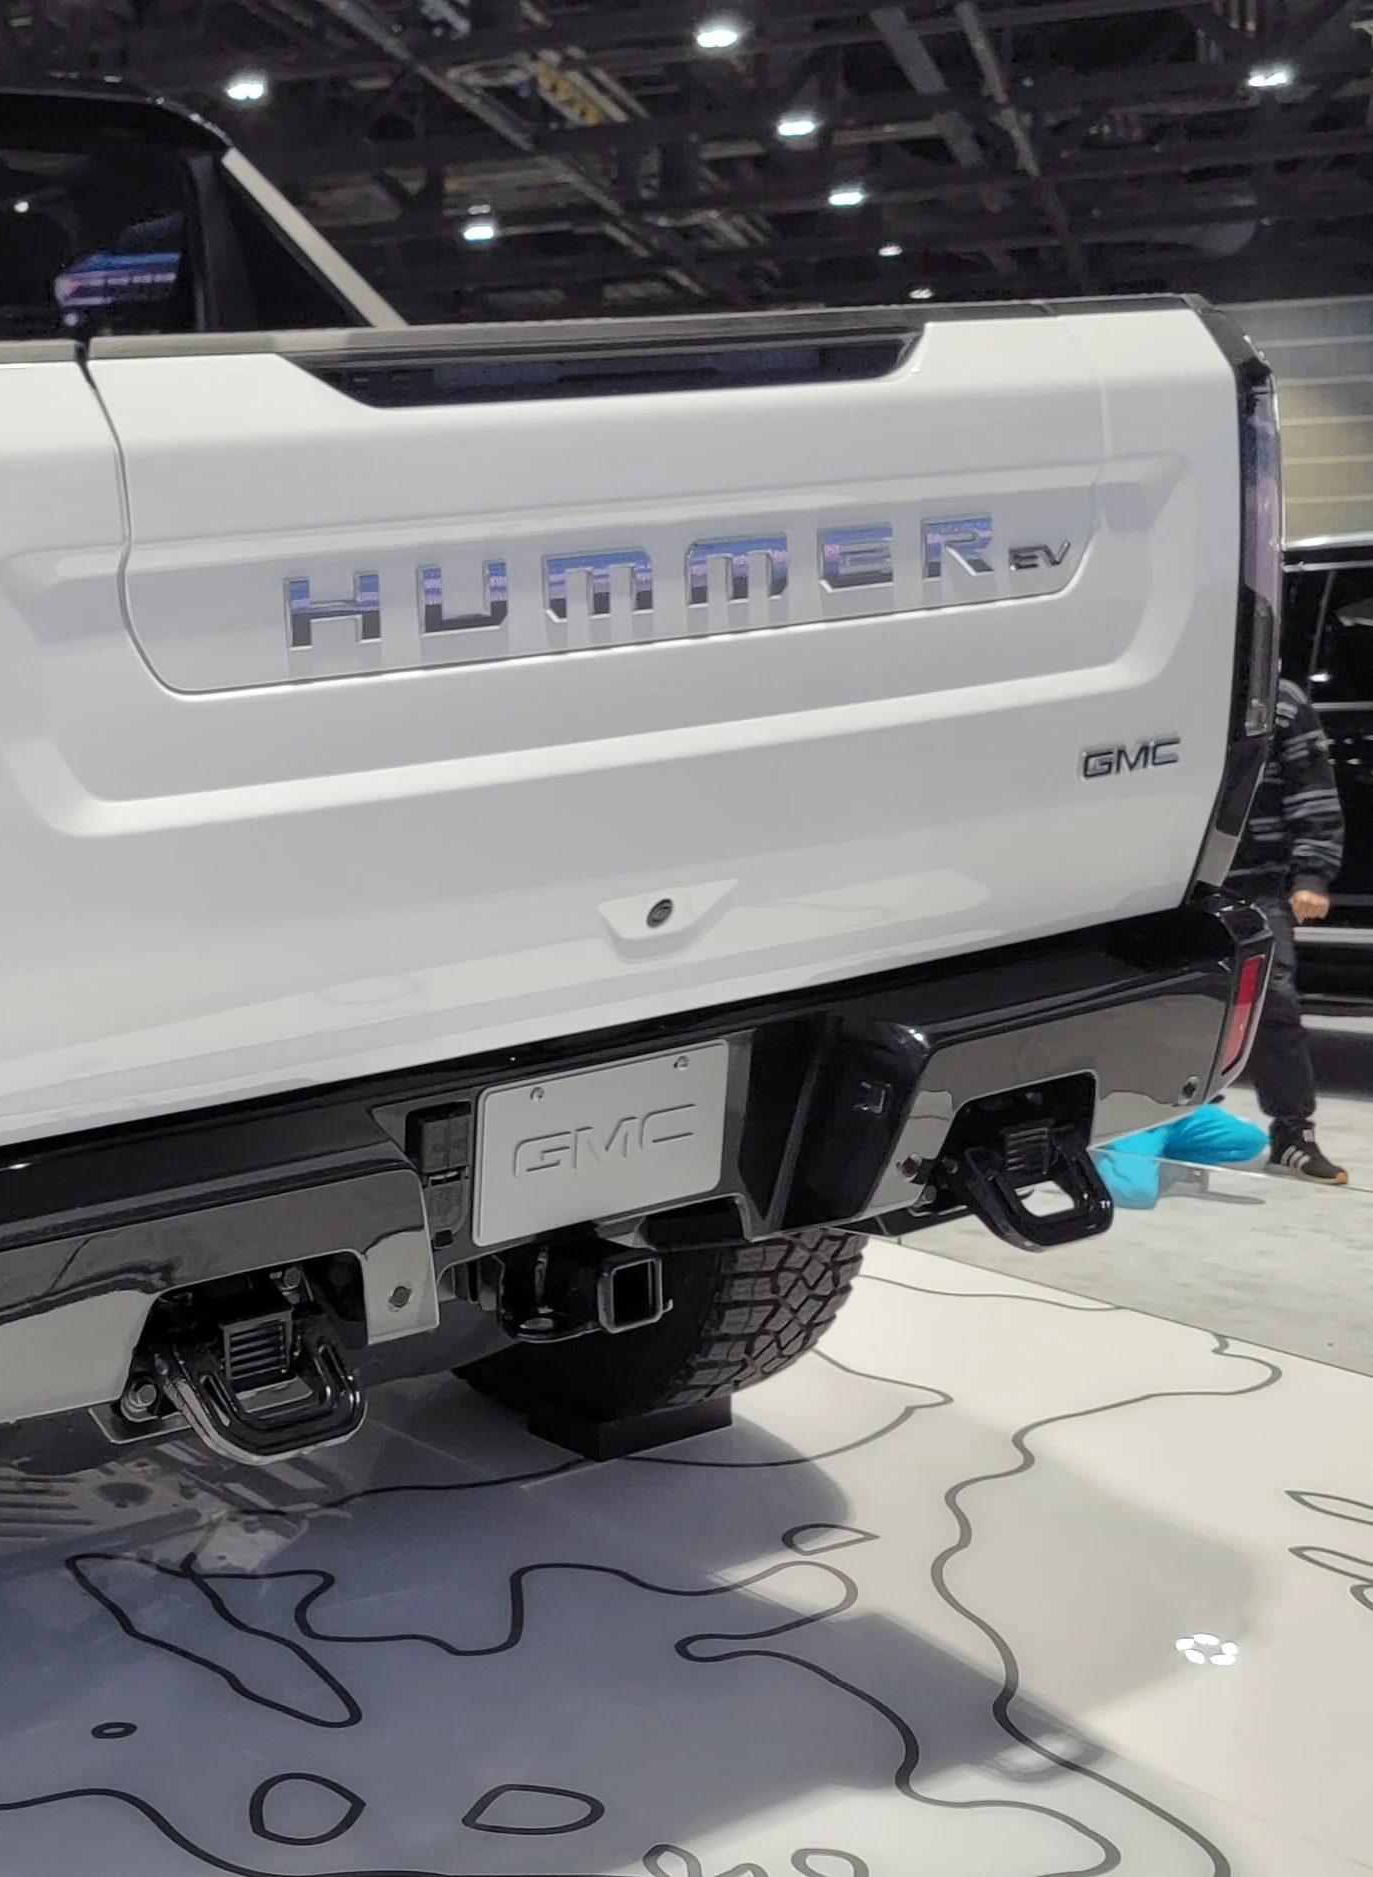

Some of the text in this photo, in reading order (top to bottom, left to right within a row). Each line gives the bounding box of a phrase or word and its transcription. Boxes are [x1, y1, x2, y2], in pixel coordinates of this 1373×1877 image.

[283, 512, 1071, 650] HUMMER EV
[1078, 735, 1181, 781] GMC
[513, 1102, 697, 1179] GMC
